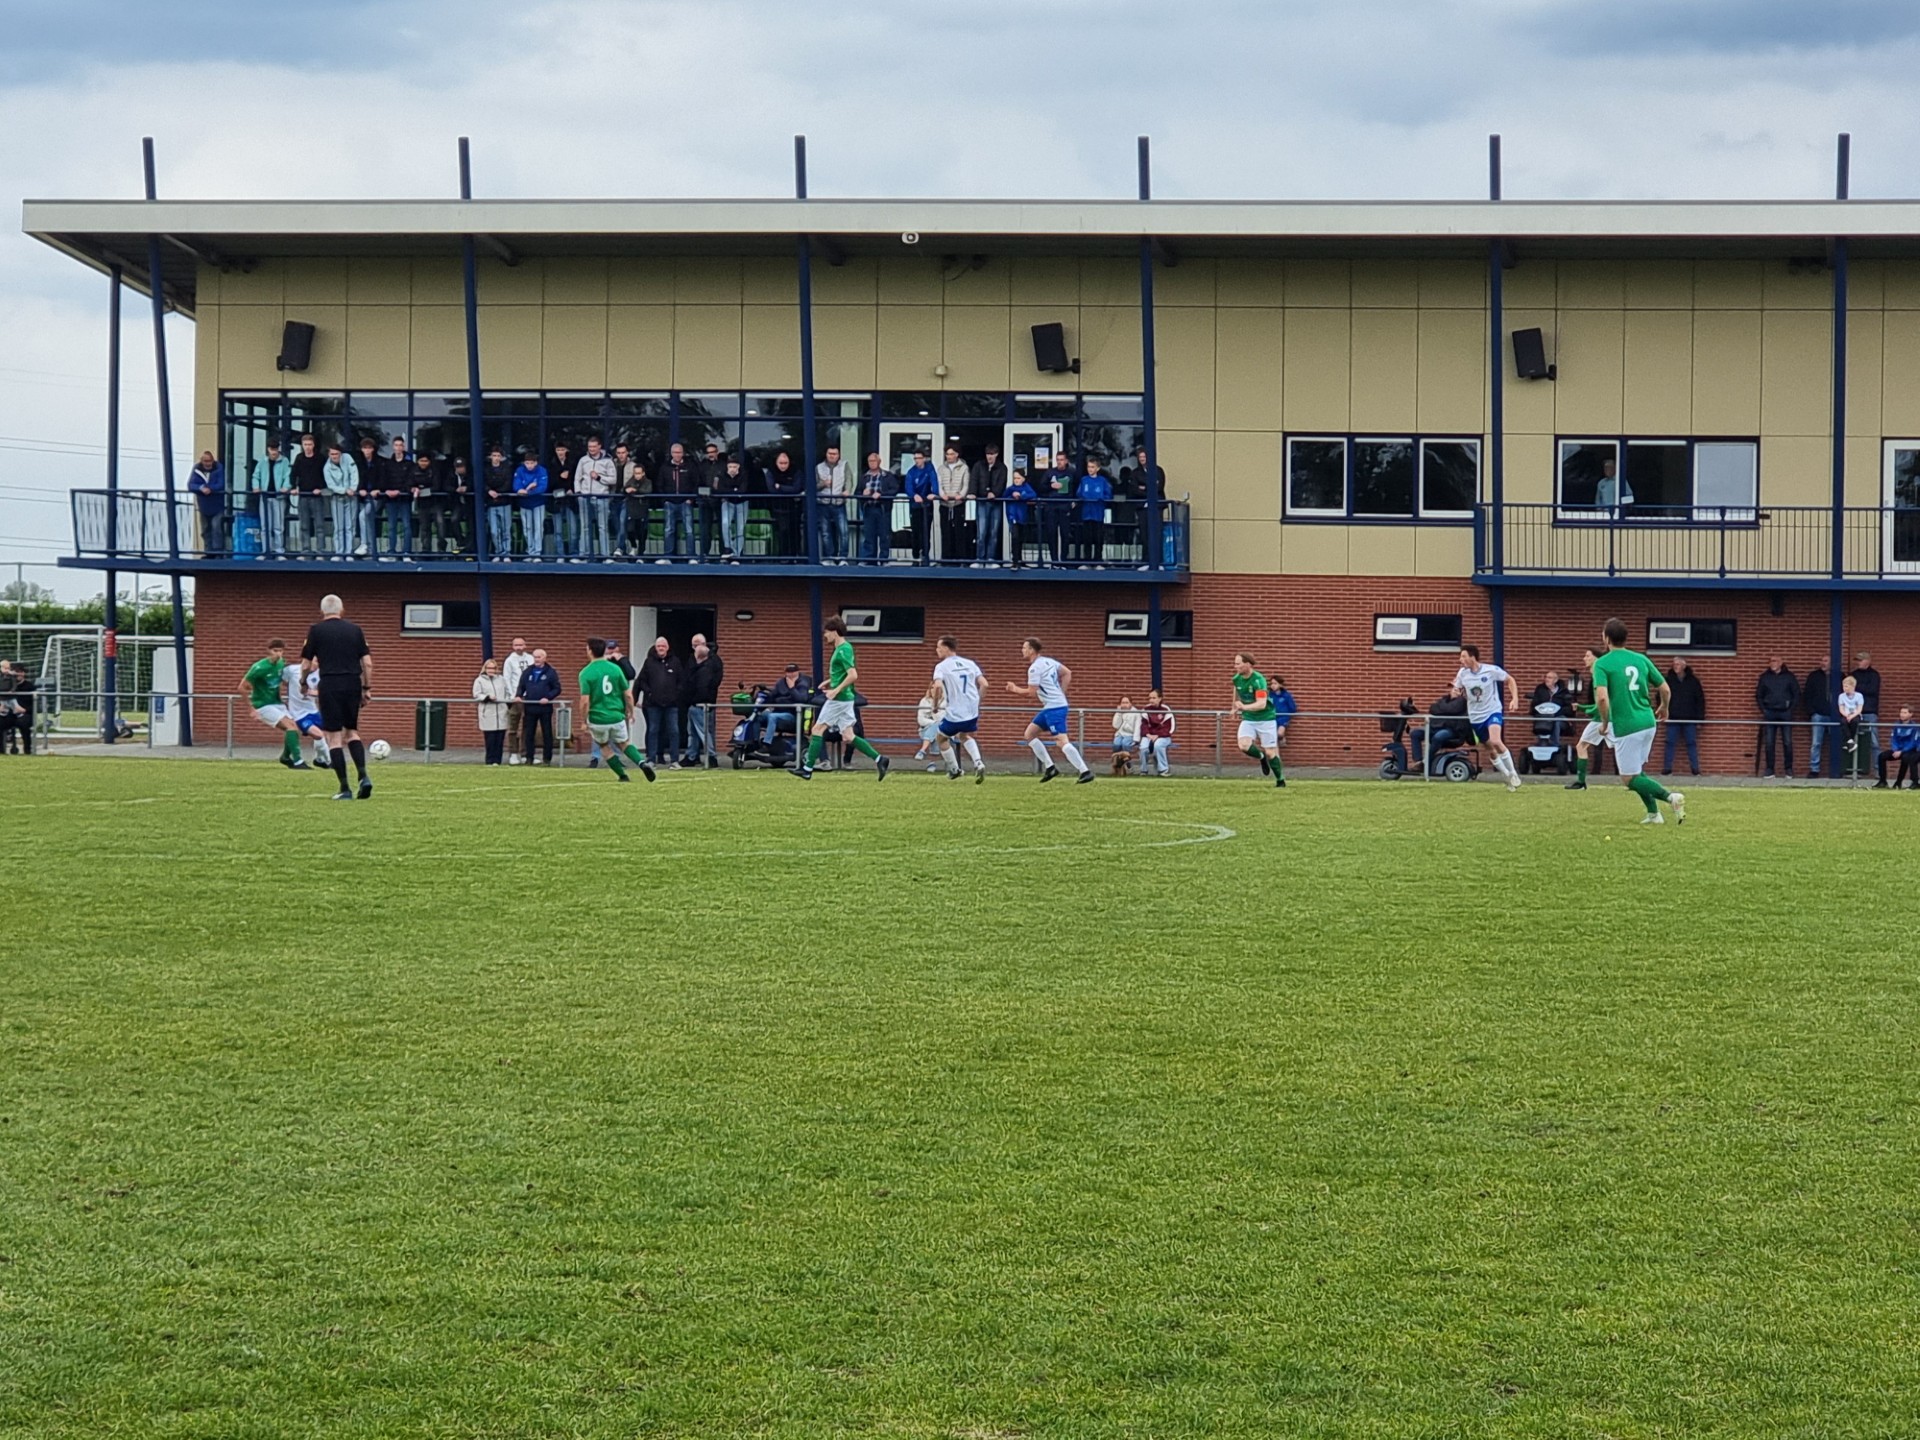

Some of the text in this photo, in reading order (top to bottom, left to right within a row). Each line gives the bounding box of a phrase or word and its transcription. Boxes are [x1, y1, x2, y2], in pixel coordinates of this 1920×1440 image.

[602, 674, 613, 695] 6
[959, 674, 967, 694] 7
[1625, 666, 1640, 690] 2
